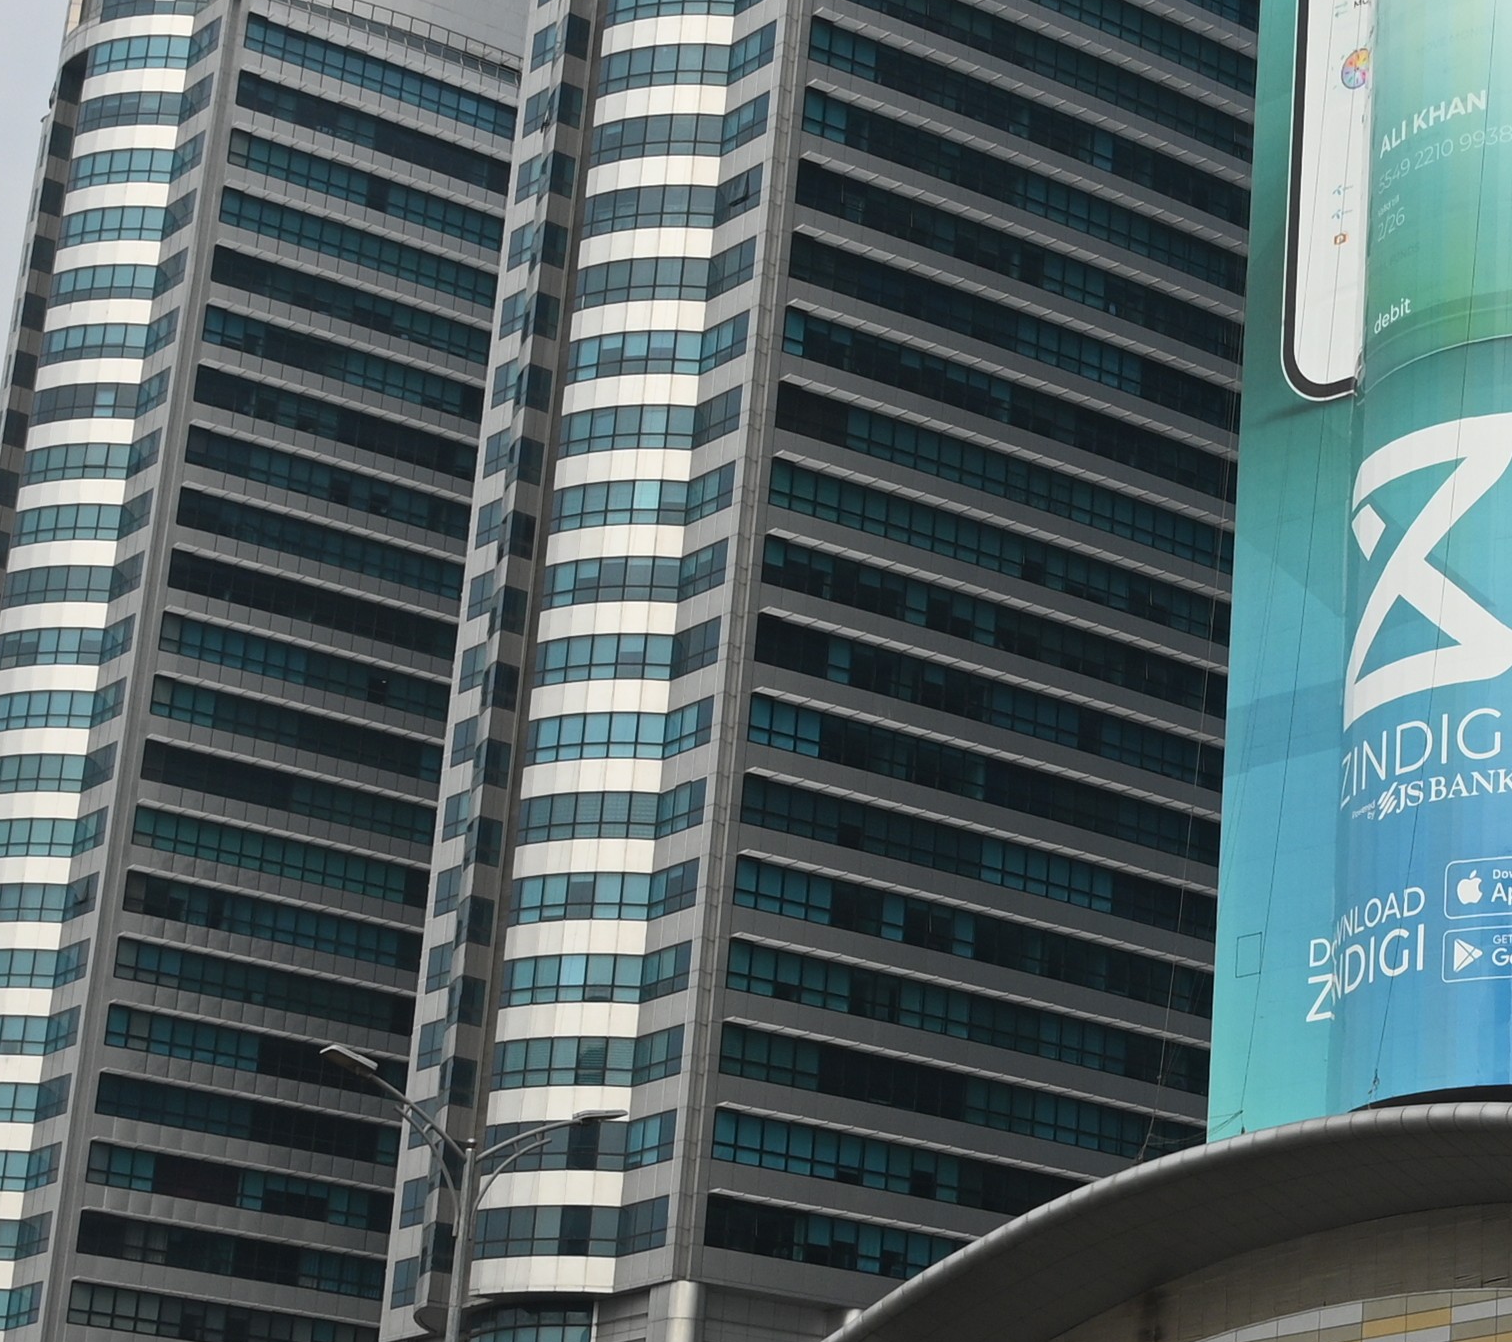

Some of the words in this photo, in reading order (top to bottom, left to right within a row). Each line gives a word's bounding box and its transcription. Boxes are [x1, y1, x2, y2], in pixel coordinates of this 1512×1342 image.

[1379, 119, 1407, 159] ALI
[1413, 90, 1487, 135] KHAN
[1414, 139, 1454, 171] 2210
[1373, 296, 1412, 335] debit
[1395, 780, 1425, 814] JS
[1492, 934, 1511, 945] GET
